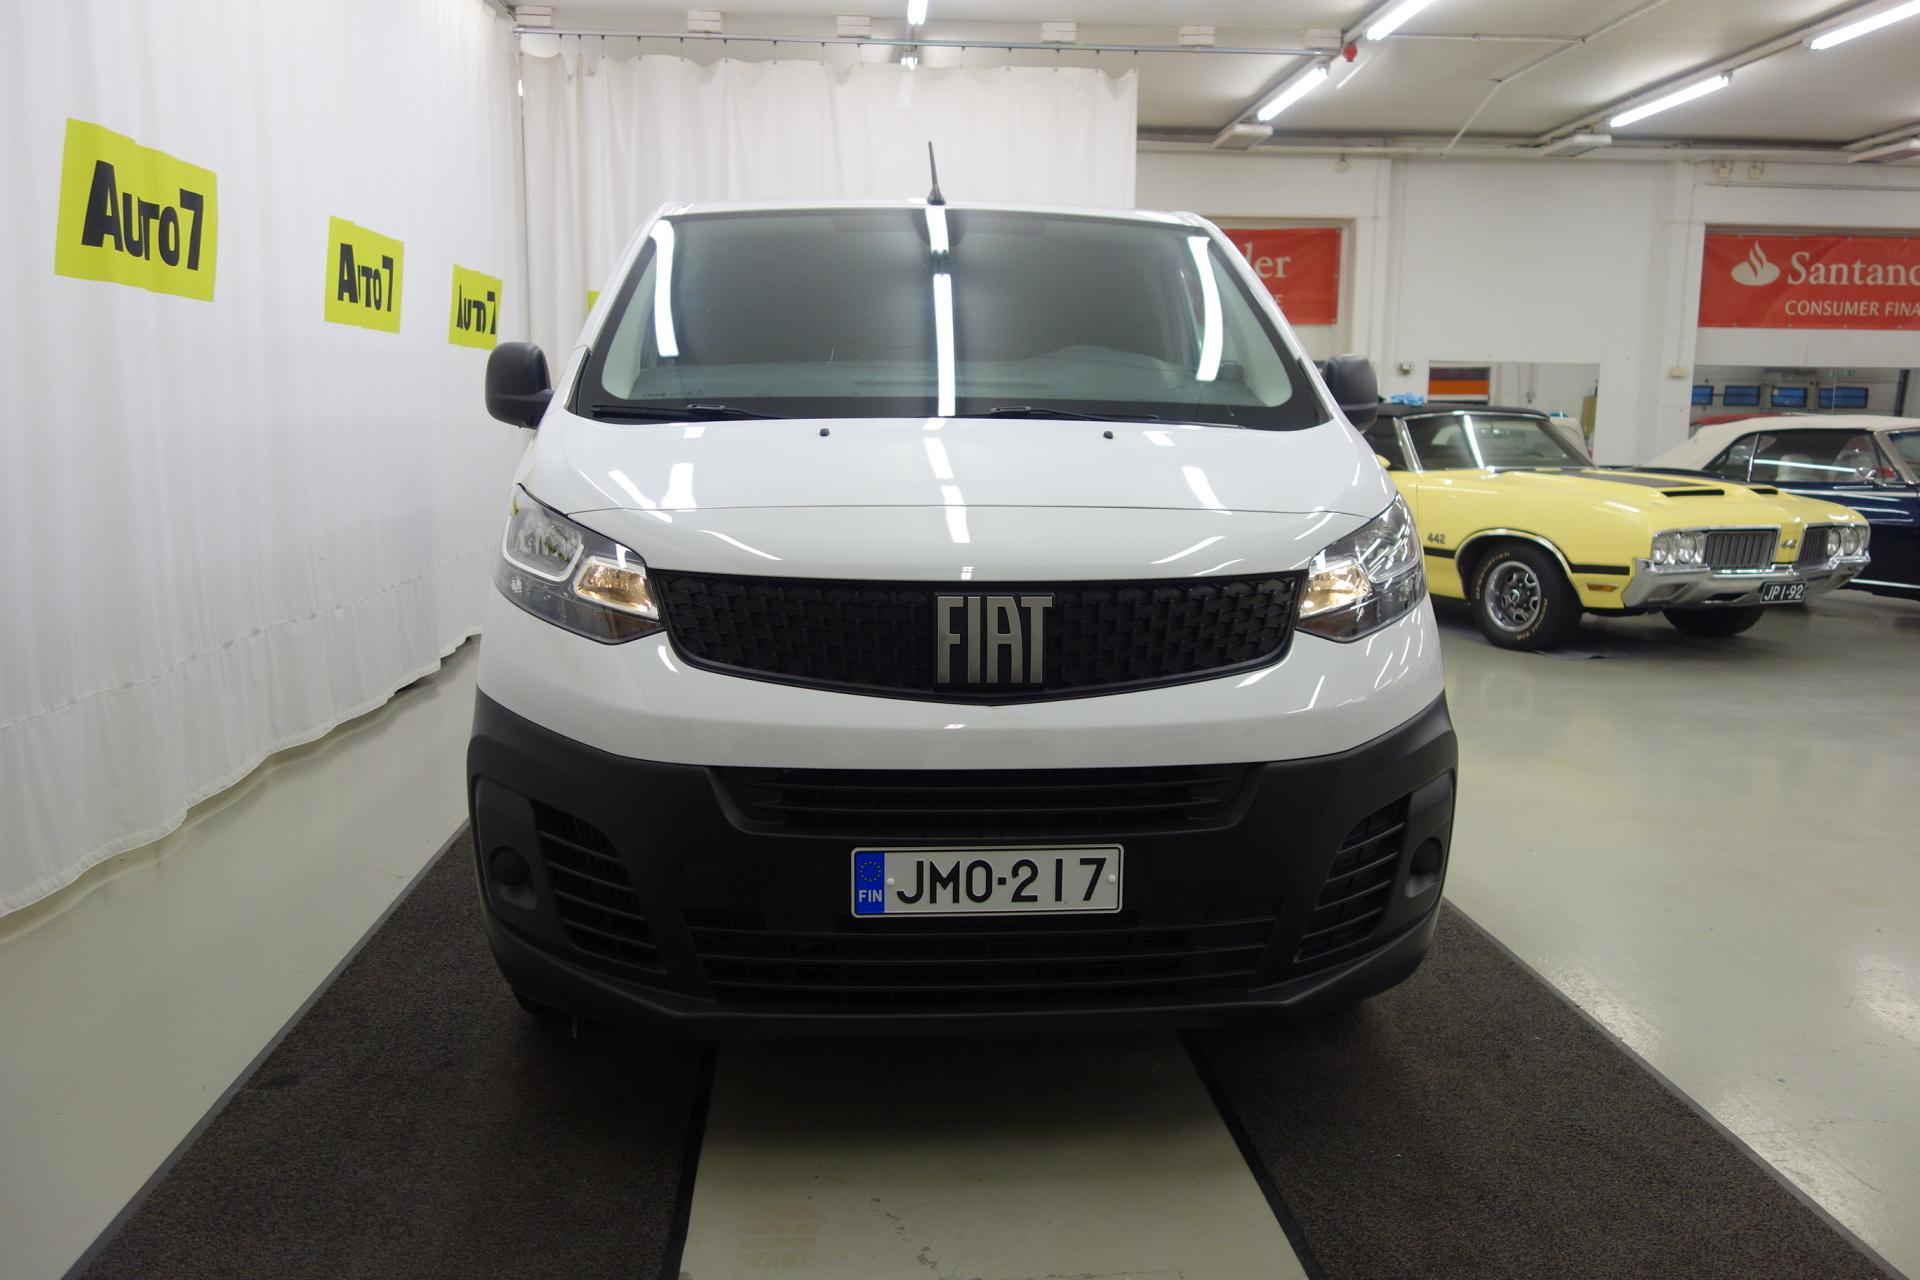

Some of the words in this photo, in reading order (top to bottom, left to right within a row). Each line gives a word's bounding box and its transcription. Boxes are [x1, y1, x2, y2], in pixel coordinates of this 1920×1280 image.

[1785, 300, 1879, 316] CONSUMER
[937, 596, 1053, 684] FIAT
[858, 889, 883, 903] FIN
[896, 857, 1107, 905] JMO-217
